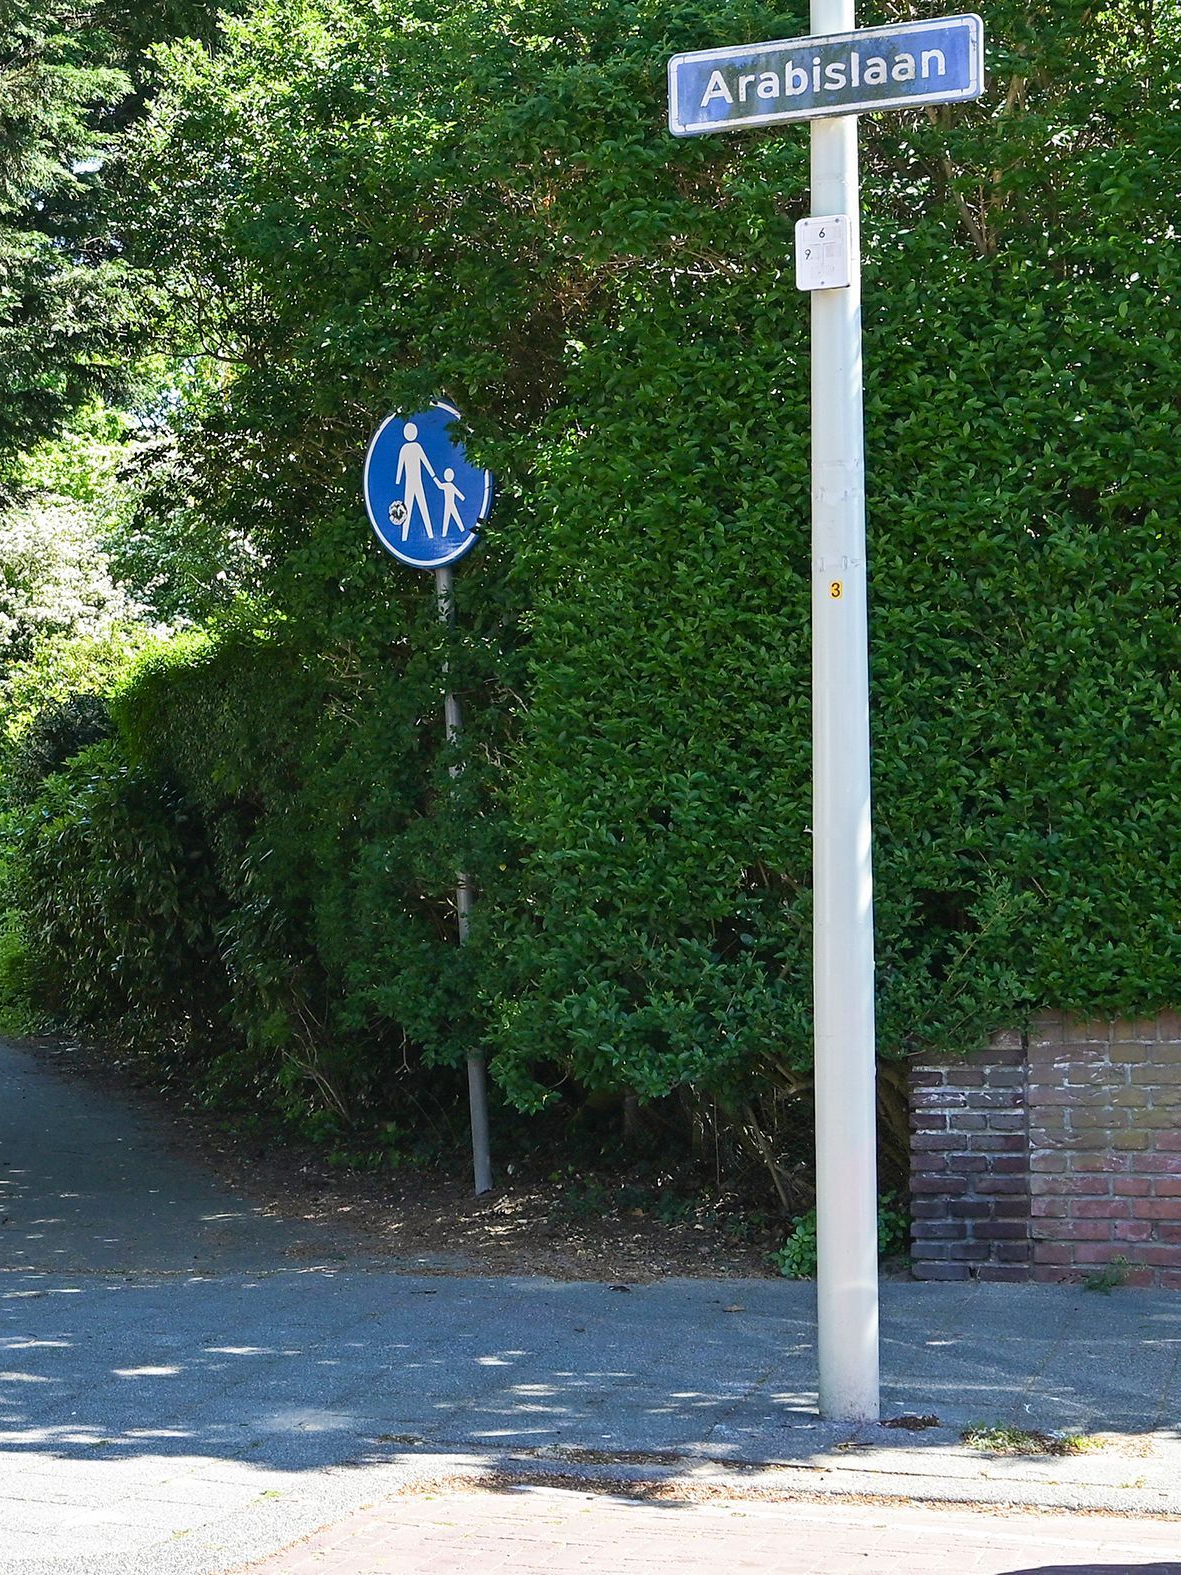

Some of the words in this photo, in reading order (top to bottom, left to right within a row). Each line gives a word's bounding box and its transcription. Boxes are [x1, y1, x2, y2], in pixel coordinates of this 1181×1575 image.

[700, 49, 946, 108] Arabislaan
[818, 227, 826, 239] 6
[804, 249, 812, 260] 9
[831, 582, 841, 598] 3
